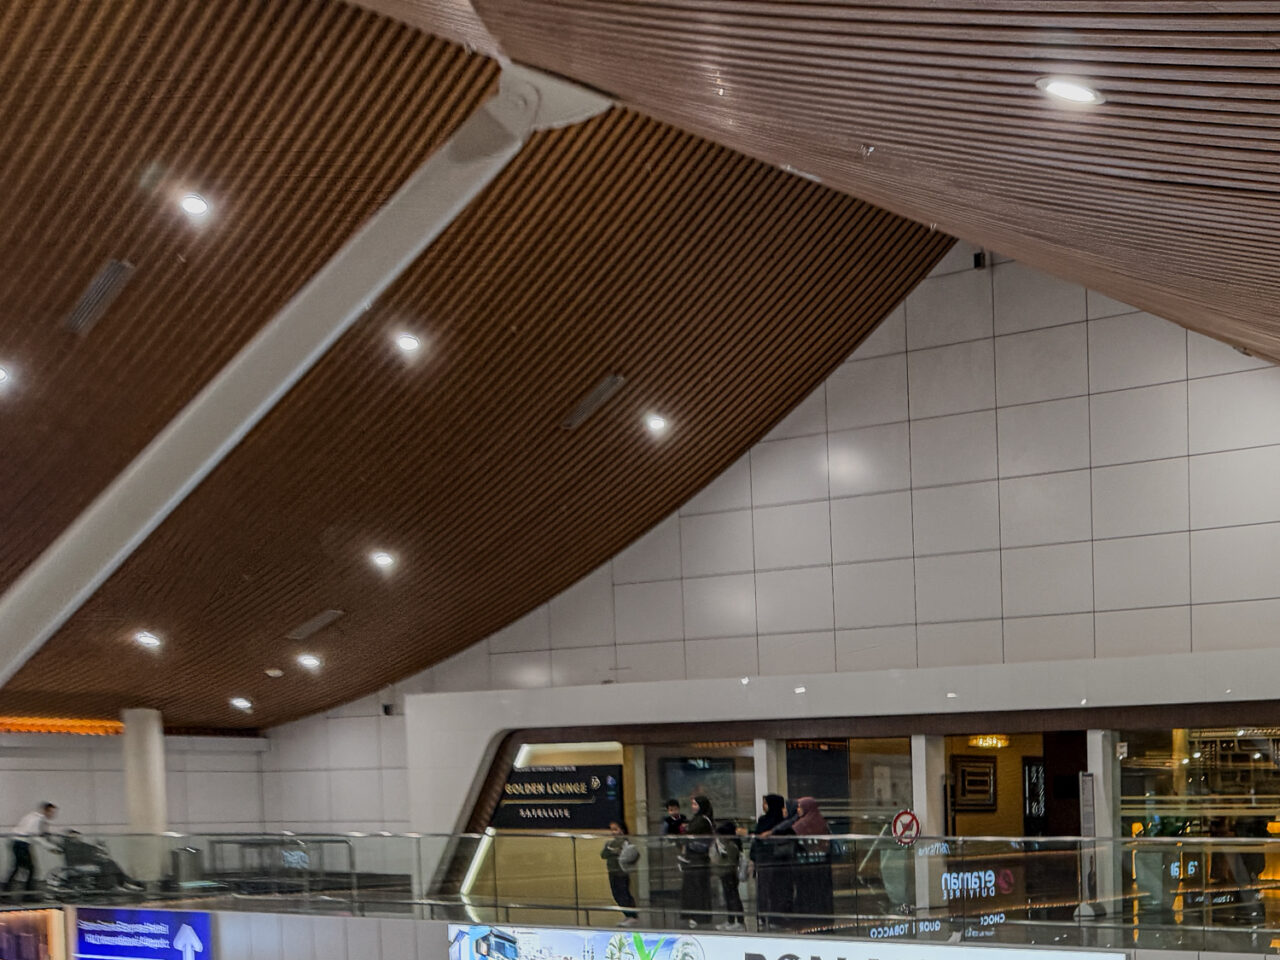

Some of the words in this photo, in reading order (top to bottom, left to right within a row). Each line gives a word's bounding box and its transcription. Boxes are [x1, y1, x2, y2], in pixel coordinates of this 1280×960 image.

[504, 782, 545, 795] GOLDEN
[546, 782, 588, 795] LOUNGE
[519, 808, 571, 819] SATELLITE
